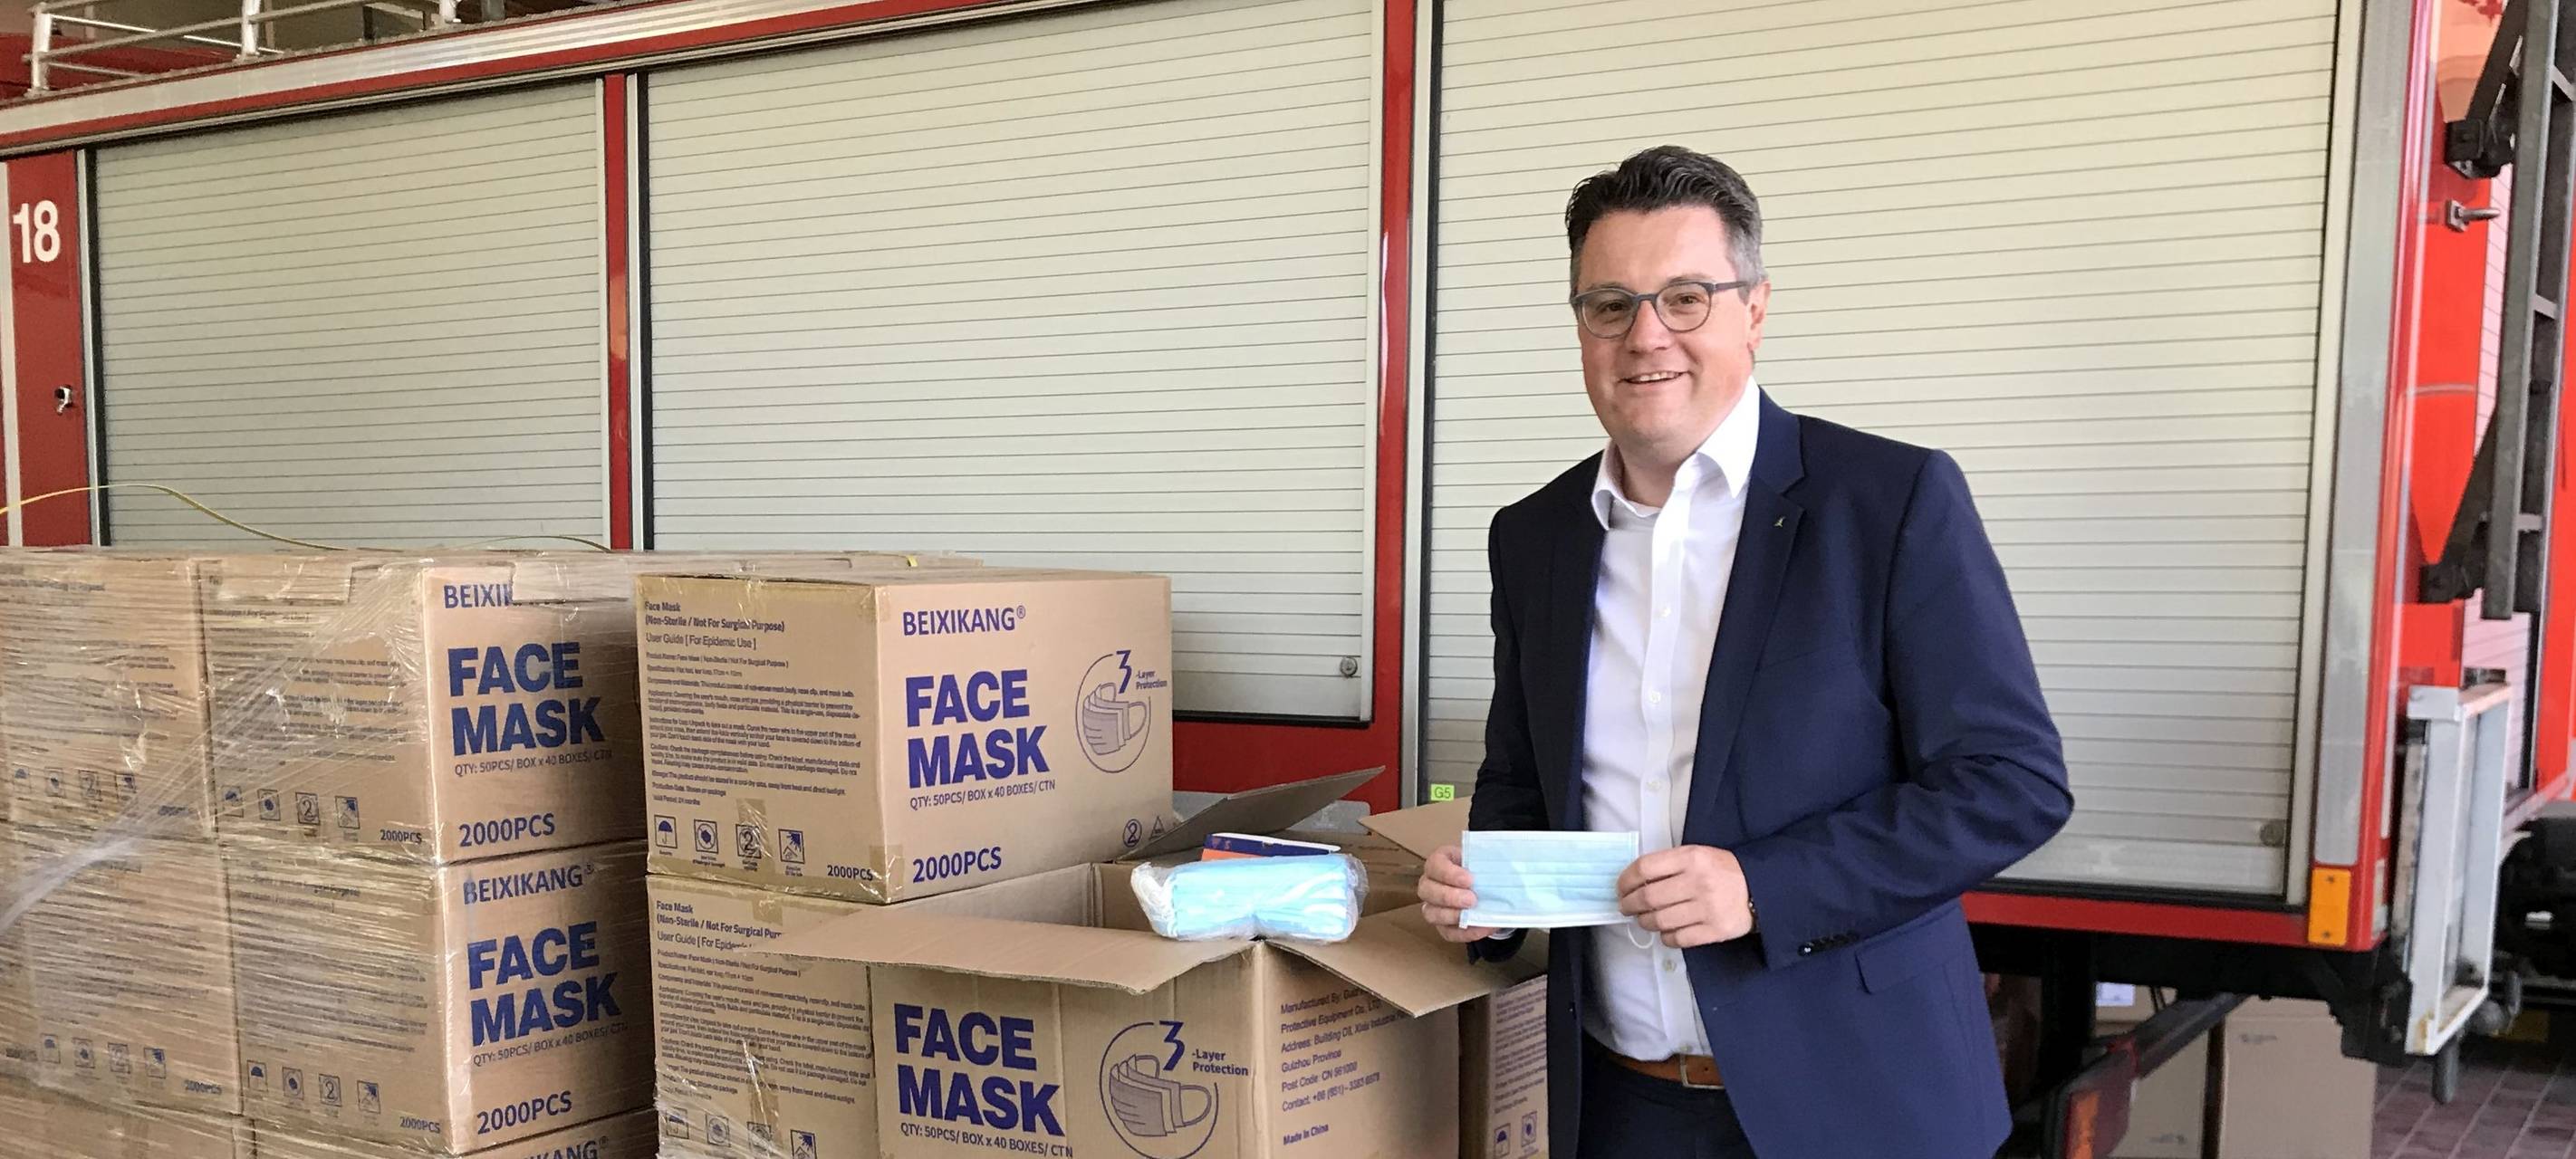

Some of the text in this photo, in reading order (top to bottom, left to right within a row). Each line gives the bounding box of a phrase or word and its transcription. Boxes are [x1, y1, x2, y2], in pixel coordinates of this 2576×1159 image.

[13, 200, 61, 263] 18
[645, 601, 681, 612] Face Mask
[693, 618, 707, 627] Not
[707, 618, 720, 628] For
[752, 620, 785, 634] Purpose)
[646, 632, 663, 644] User
[663, 633, 684, 645] Guide
[689, 635, 701, 646] For
[702, 635, 735, 648] Epidemic
[737, 637, 752, 648] Use
[447, 641, 583, 697] FACE
[1115, 649, 1133, 694] 3
[1135, 679, 1168, 691] Protection
[906, 668, 1030, 728] FACE
[451, 696, 605, 756] MASK
[455, 763, 477, 778] QTY:
[516, 756, 536, 769] BOX
[544, 755, 557, 766] 40
[907, 725, 1051, 789] MASK
[909, 779, 1056, 811] QTY: 50PCS/ BOX x 40 BOXES/ CTN
[1434, 786, 1451, 799] G5
[380, 829, 423, 845] 2000PCS
[458, 812, 556, 848] 2000PCS
[827, 864, 874, 882] 2000PCS
[912, 846, 1002, 884] 2000PCS
[656, 900, 694, 914] Face Mask
[657, 931, 675, 943] User
[675, 933, 697, 945] Guide
[701, 936, 715, 948] For
[706, 920, 720, 931] Not
[720, 922, 733, 933] For
[734, 924, 764, 938] Surgical
[466, 920, 601, 991] FACE
[470, 972, 622, 1047] MASK
[1281, 995, 1330, 1015] Manufactured
[893, 1002, 1037, 1071] FACE
[1281, 1019, 1317, 1034] Protective
[1313, 1029, 1341, 1046] Building
[473, 1051, 496, 1067] QTY:
[533, 1039, 554, 1053] BOX
[562, 1034, 573, 1046] 40
[1158, 1020, 1185, 1071] 3
[1312, 1049, 1342, 1065] Province
[1192, 1061, 1249, 1077] Protection
[1282, 1079, 1298, 1093] Post
[898, 1064, 1065, 1137] MASK
[476, 1090, 573, 1135] 2000PCS
[399, 1116, 441, 1135] 2000PCS
[1283, 1132, 1302, 1145] Made
[1311, 1124, 1329, 1137] China
[900, 1122, 1073, 1158] QTY: 50PCS/ BOX x 40 BOXES/ CTN
